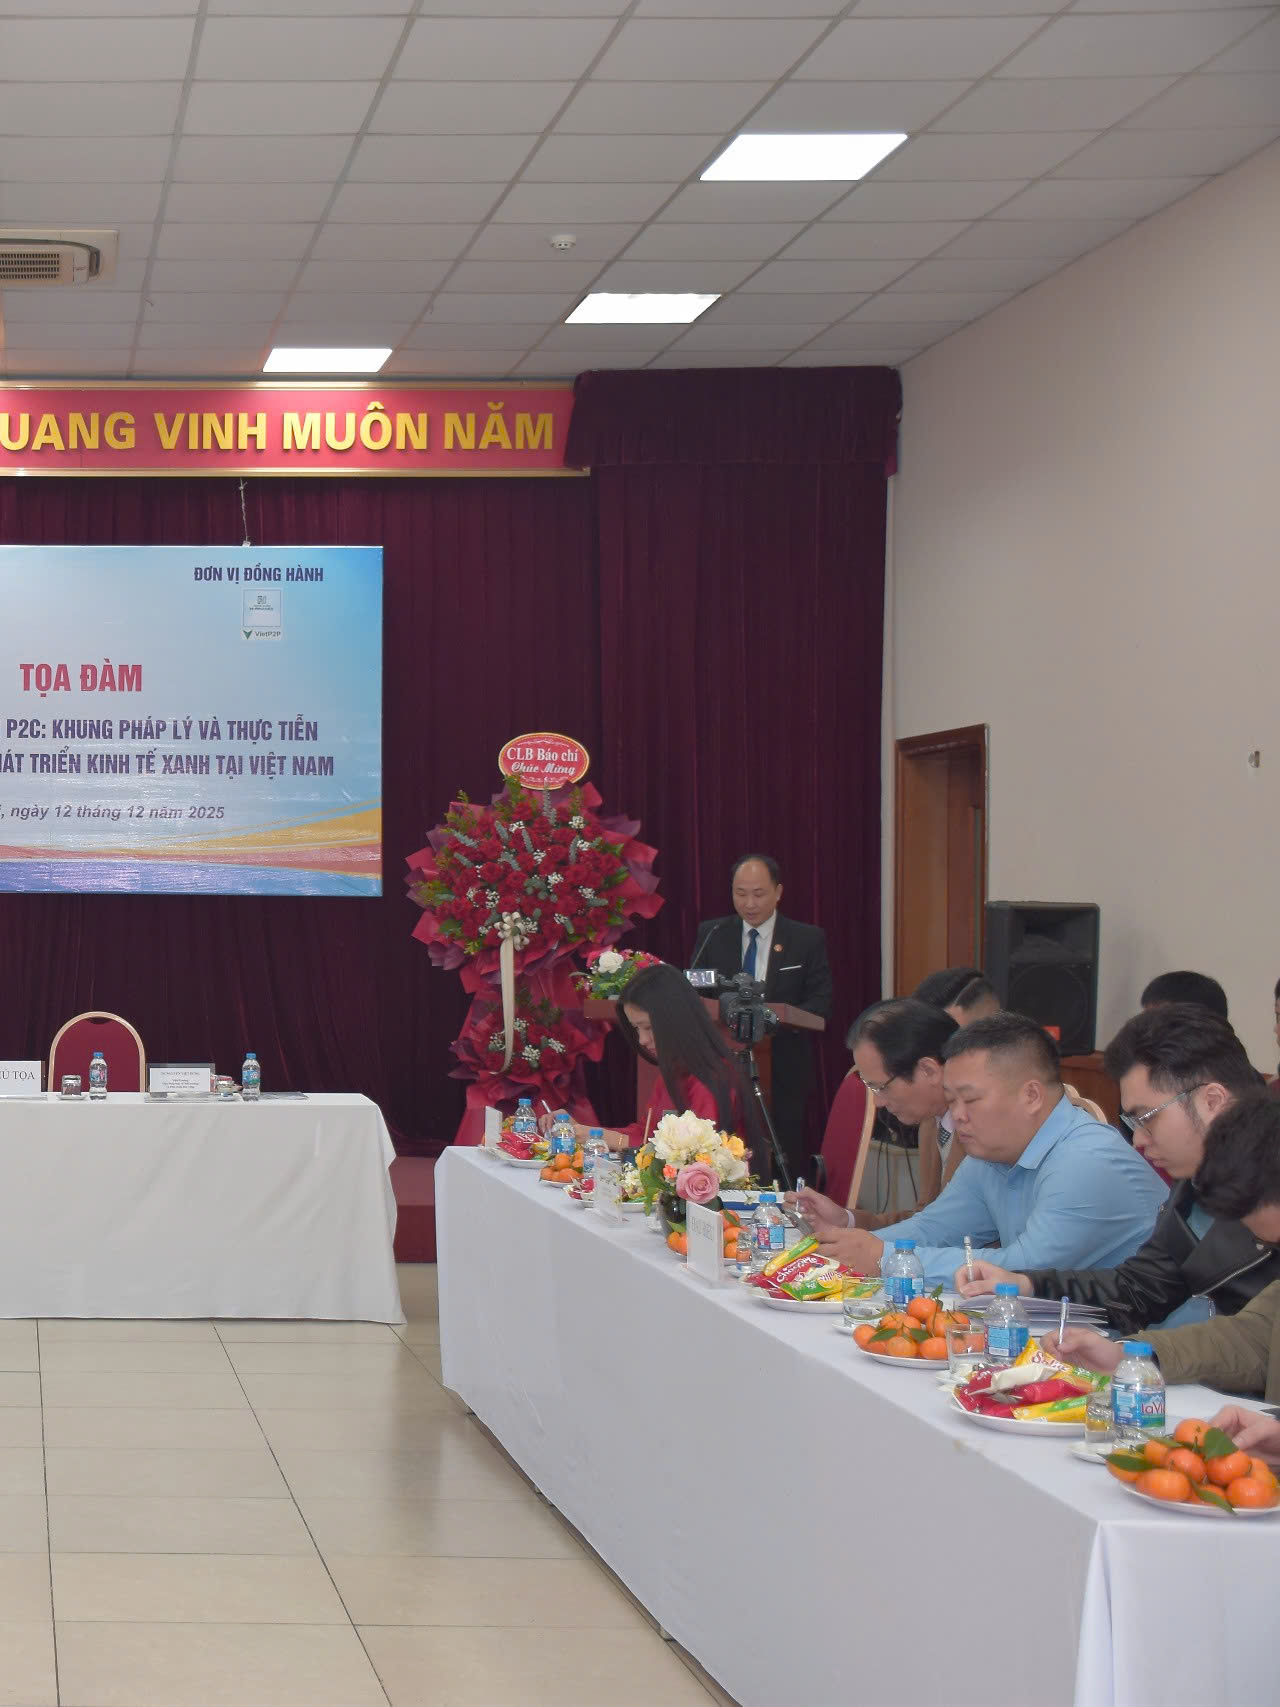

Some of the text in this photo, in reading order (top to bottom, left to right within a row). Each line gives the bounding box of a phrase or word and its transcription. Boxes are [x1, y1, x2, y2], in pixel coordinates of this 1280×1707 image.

[154, 413, 267, 450] VINH
[283, 401, 427, 450] MUÔN
[444, 401, 553, 450] NĂM
[194, 566, 222, 581] ĐƠN
[227, 567, 239, 584] VỊ
[286, 564, 324, 581] HÀNH
[20, 658, 142, 697] TỌA ĐÀM
[7, 719, 46, 739] P2C:
[52, 719, 112, 740] KHUNG
[120, 716, 166, 740] PHÁP
[173, 716, 193, 740] LÝ
[198, 716, 221, 740] VÀ
[227, 718, 272, 745] THỰC
[278, 714, 318, 741] TIỄN
[30, 746, 81, 774] TRIỂN
[88, 754, 129, 774] KINH
[136, 748, 157, 774] TẾ
[162, 754, 210, 775] XANH
[216, 755, 243, 779] TẠI
[249, 752, 286, 779] VIỆT
[292, 756, 334, 776] NAM
[506, 747, 578, 762] CLB Báo chí
[511, 761, 575, 776] Chúc Mừng
[10, 806, 49, 820] ngày
[55, 806, 72, 818] 12
[77, 805, 121, 820] tháng
[127, 806, 144, 818] 12
[149, 806, 182, 819] năm
[188, 806, 224, 819] 2025
